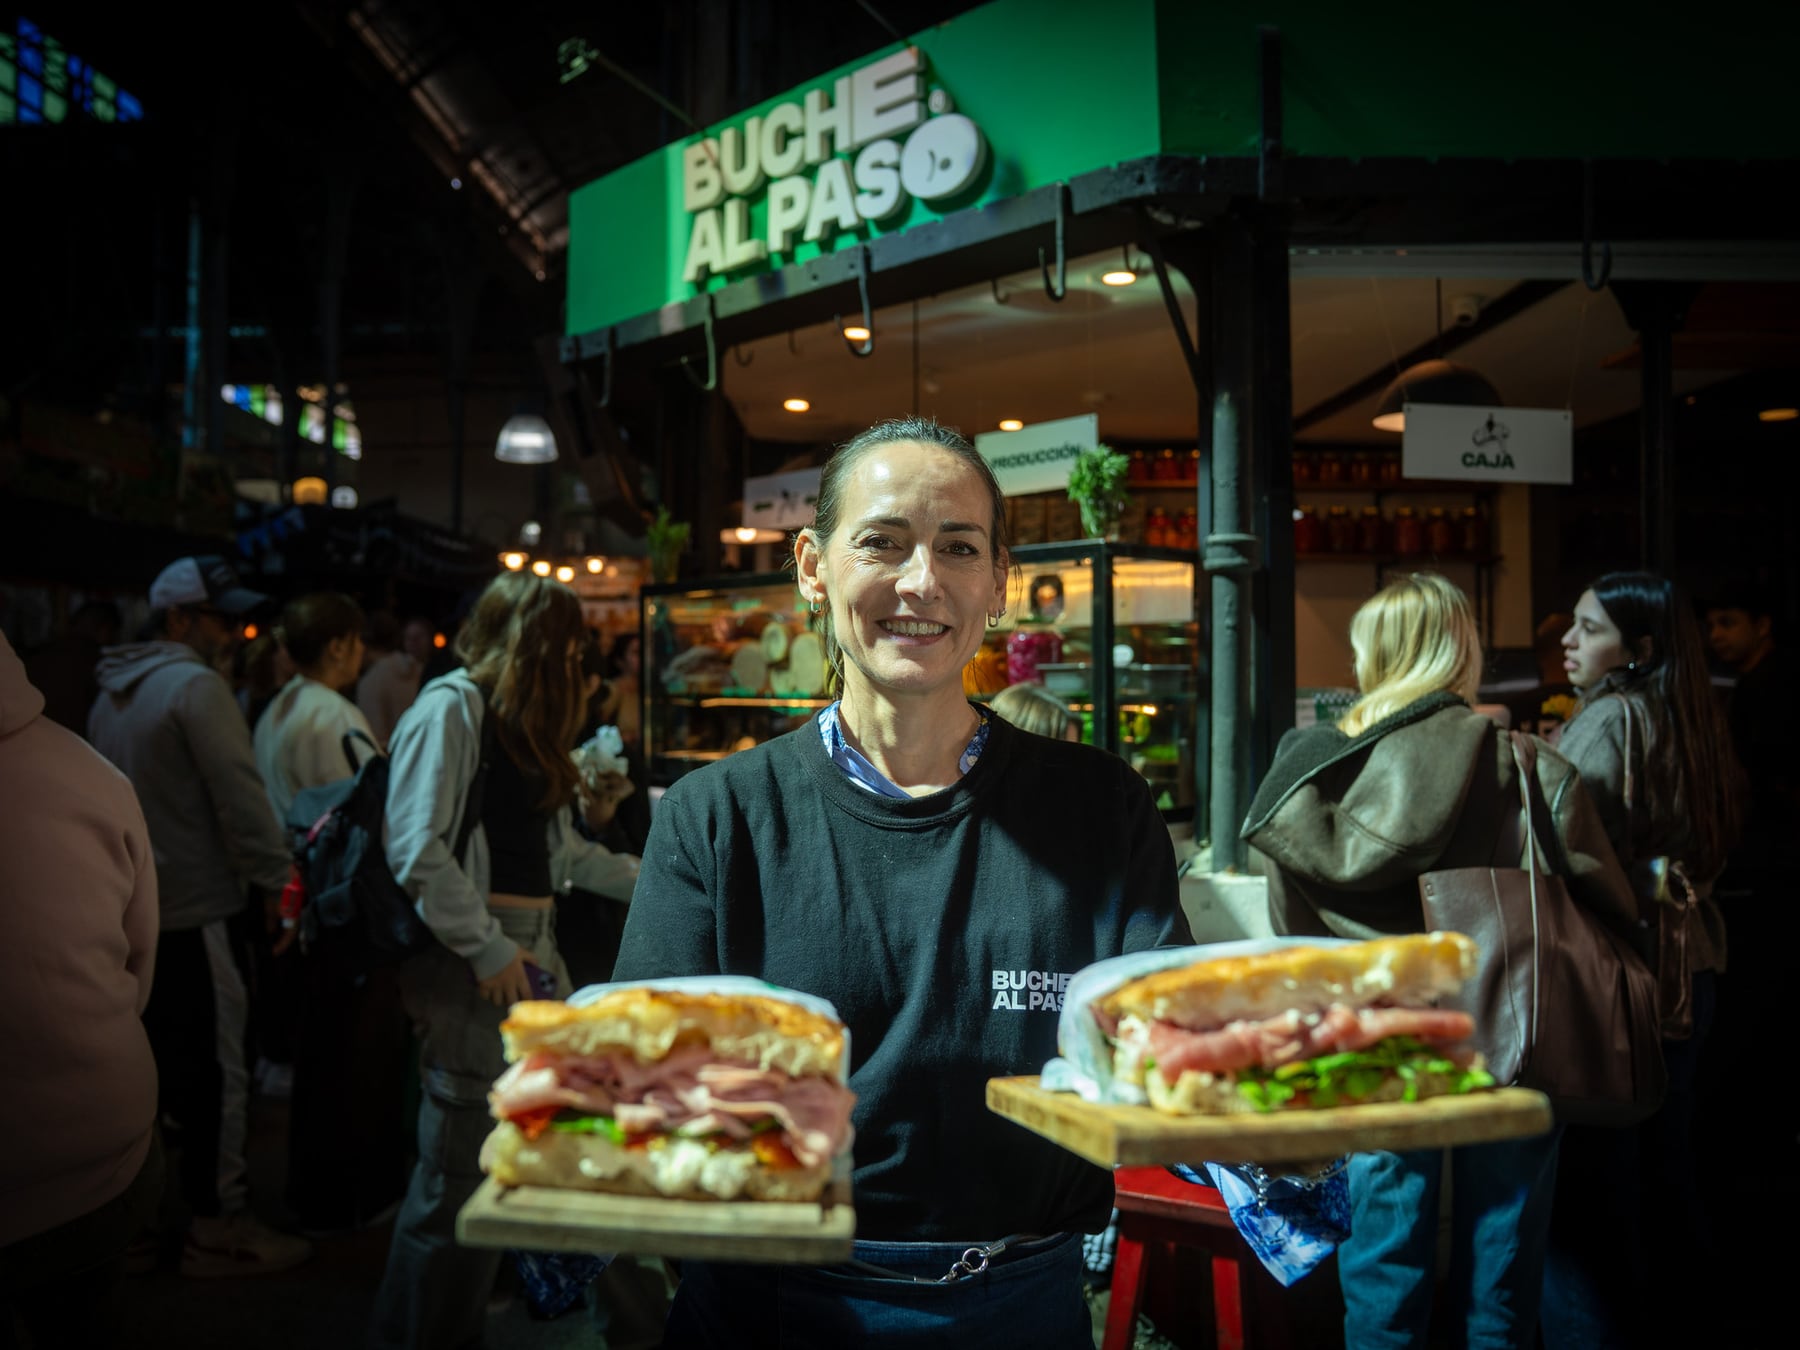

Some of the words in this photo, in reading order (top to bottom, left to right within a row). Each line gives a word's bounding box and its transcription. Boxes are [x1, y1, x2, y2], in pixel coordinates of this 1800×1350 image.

[684, 46, 923, 212] BUCHE
[683, 200, 766, 282] AL
[767, 113, 987, 252] PASO
[1461, 452, 1515, 469] CAJA
[992, 970, 1074, 992] BUCHE
[992, 991, 1027, 1010] AL
